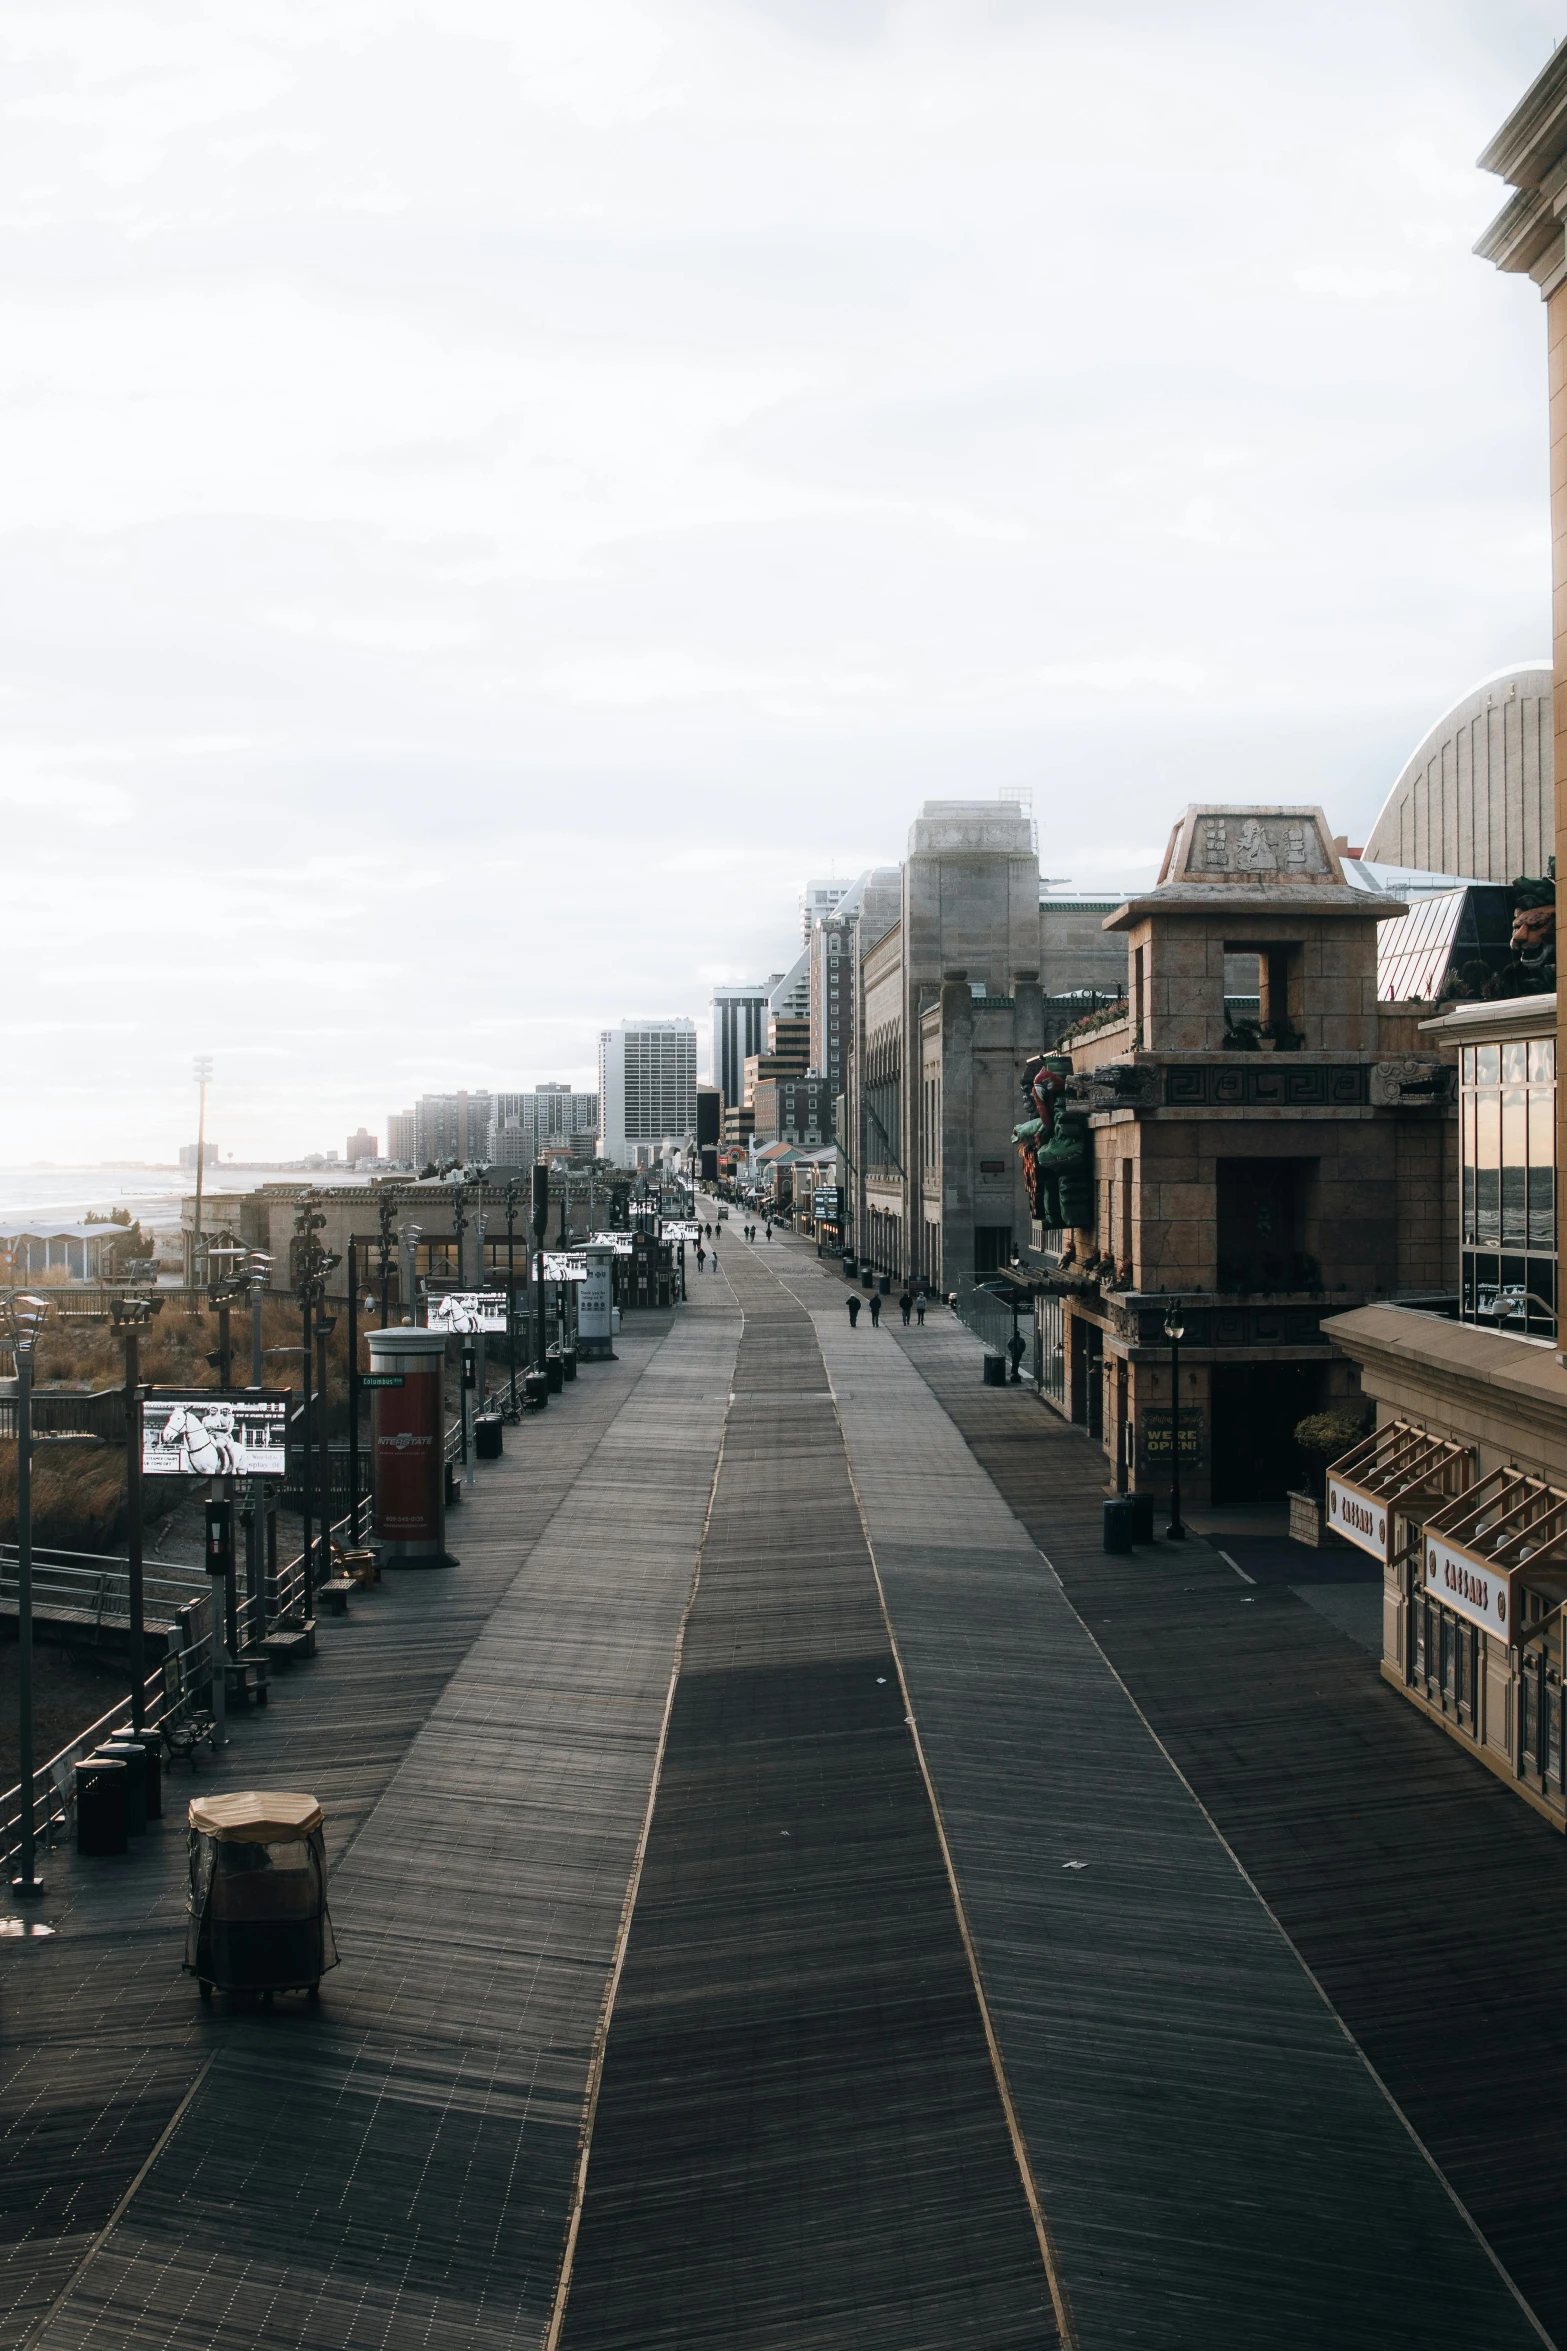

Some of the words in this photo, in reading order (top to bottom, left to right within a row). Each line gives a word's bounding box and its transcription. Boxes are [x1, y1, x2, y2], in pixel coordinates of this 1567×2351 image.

[363, 1377, 393, 1385] Columbus
[377, 1435, 433, 1446] INTERSTATE
[1147, 1430, 1197, 1440] WERE
[1341, 1496, 1373, 1537] CAESARS
[1443, 1558, 1489, 1611] CAESARS
